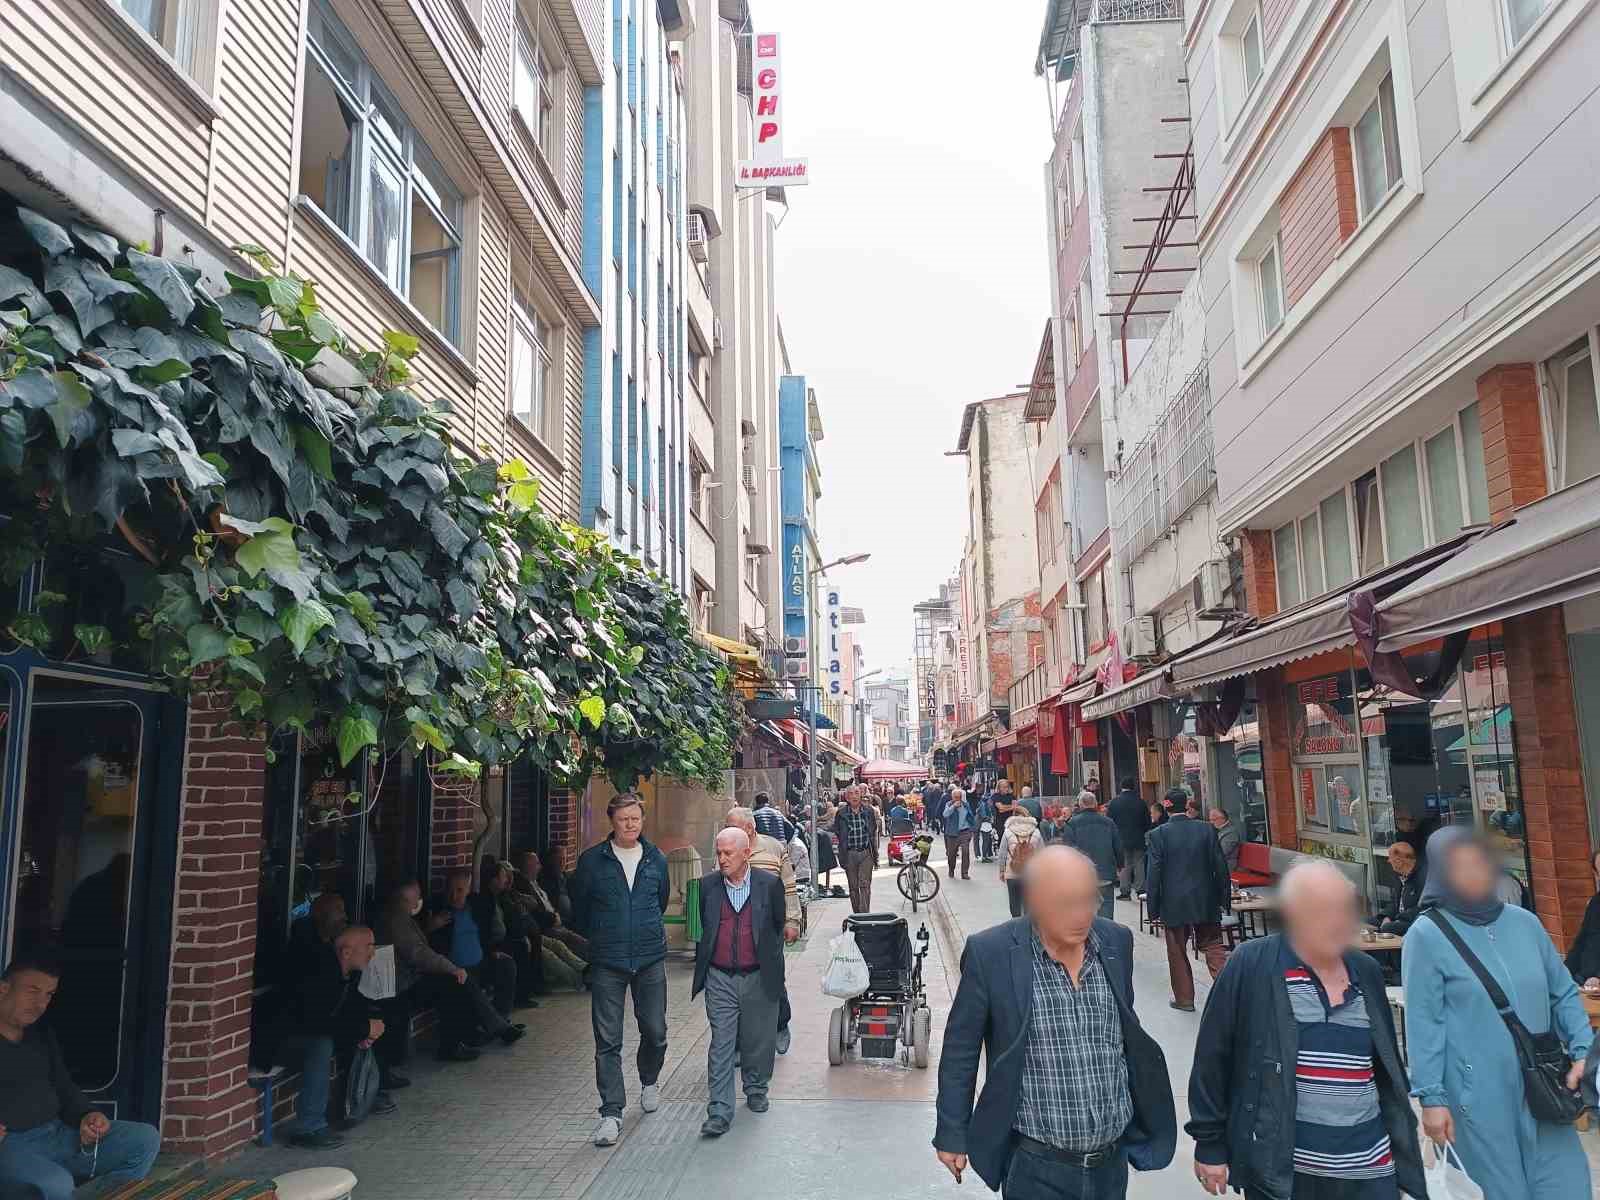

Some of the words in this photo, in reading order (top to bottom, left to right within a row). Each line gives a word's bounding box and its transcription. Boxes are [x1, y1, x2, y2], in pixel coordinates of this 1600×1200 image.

[758, 69, 777, 142] CHP
[752, 163, 806, 179] BAŞKANLIĞI
[792, 545, 802, 595] ATLAS
[828, 592, 841, 694] atlas
[928, 681, 936, 716] SAAT
[1298, 678, 1339, 704] EFE
